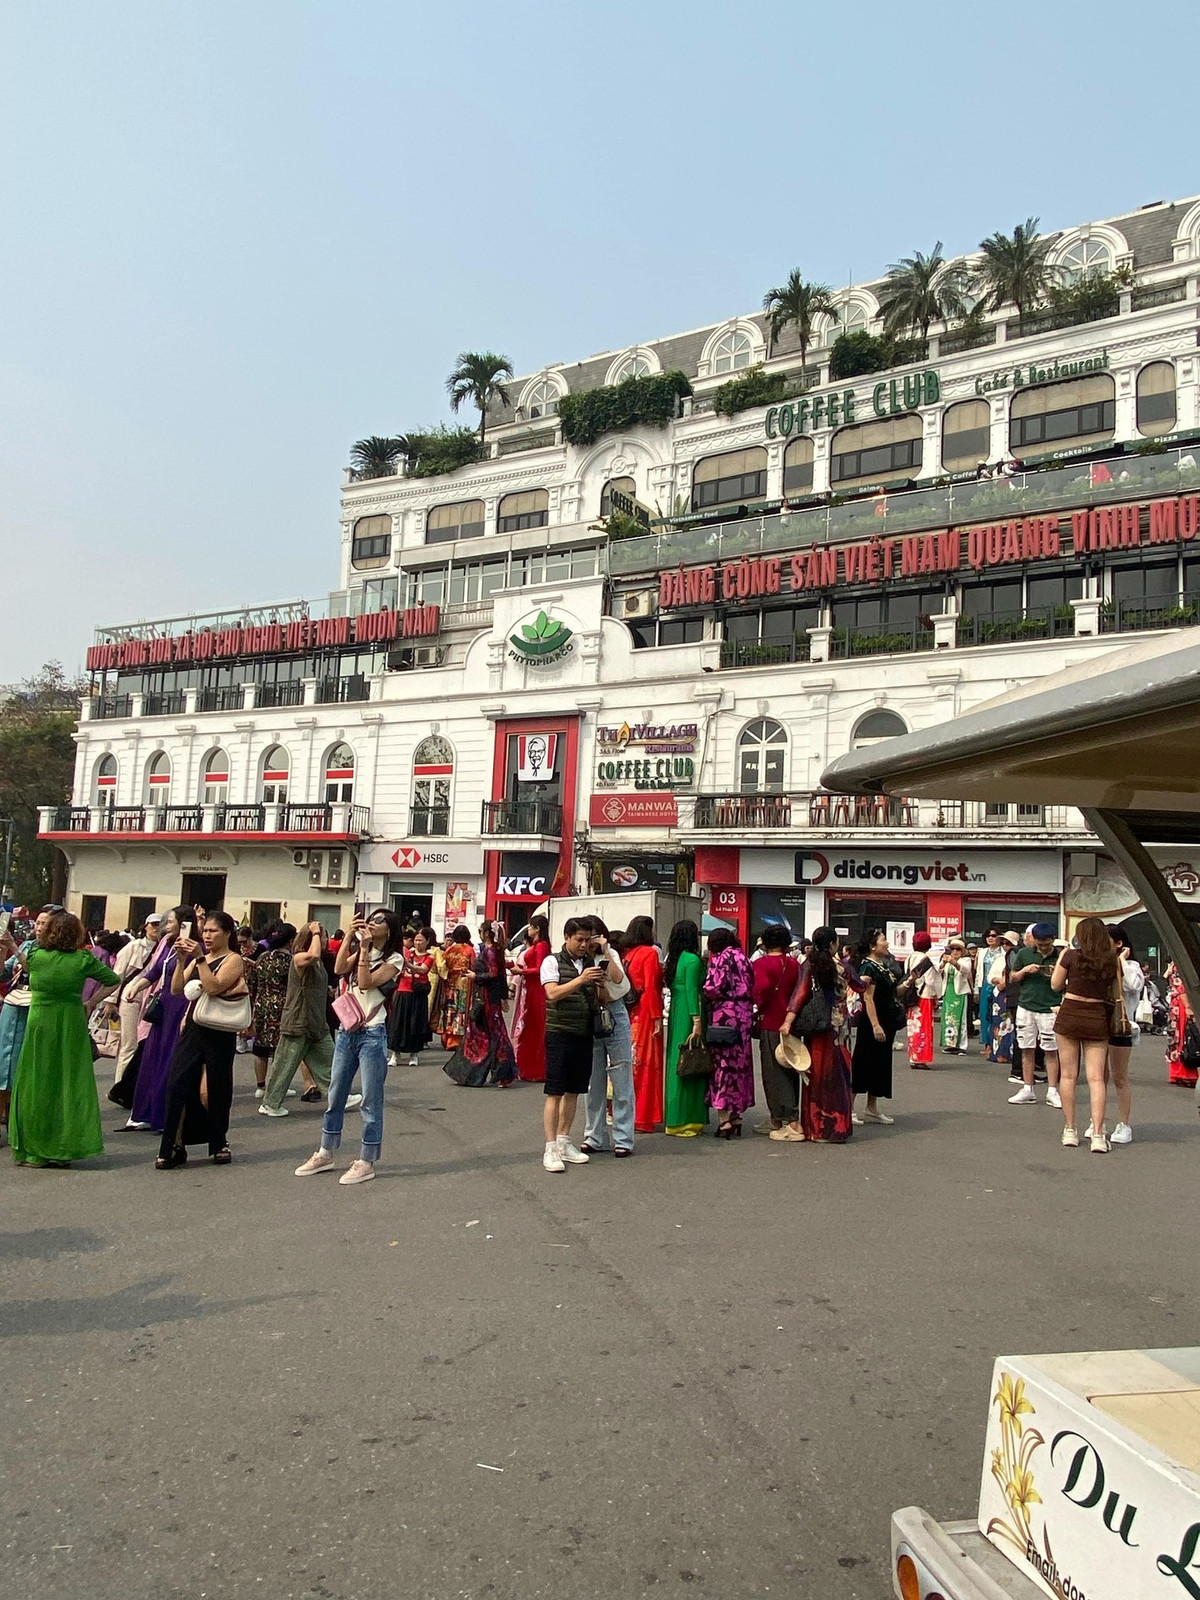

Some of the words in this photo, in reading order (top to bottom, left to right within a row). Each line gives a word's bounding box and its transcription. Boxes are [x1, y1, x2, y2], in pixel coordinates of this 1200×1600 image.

[975, 373, 1009, 395] Café
[1013, 369, 1024, 386] &
[1029, 348, 1110, 383] Restaurant
[765, 389, 855, 439] COFFEE
[873, 370, 940, 416] CLUB
[1154, 434, 1178, 444] Pizza
[1053, 446, 1093, 459] Cocktails
[859, 485, 880, 493] Salmo
[658, 562, 716, 609] ĐẢNG
[722, 555, 782, 604] CỘNG
[790, 542, 838, 591] SẢN
[843, 535, 895, 587] VIỆT
[901, 531, 960, 578] NAM
[967, 516, 1060, 571] QUANG
[1071, 505, 1141, 553] VINH
[316, 617, 350, 646] NAM
[355, 605, 399, 643] MUÔN
[402, 600, 440, 638] NĂM
[598, 759, 651, 780] COFFEE
[656, 757, 693, 777] CLUB
[423, 853, 449, 863] HSBC
[496, 876, 546, 895] KFC
[719, 892, 736, 905] 03
[1050, 1430, 1139, 1548] Du
[1026, 1539, 1059, 1586] Email:
